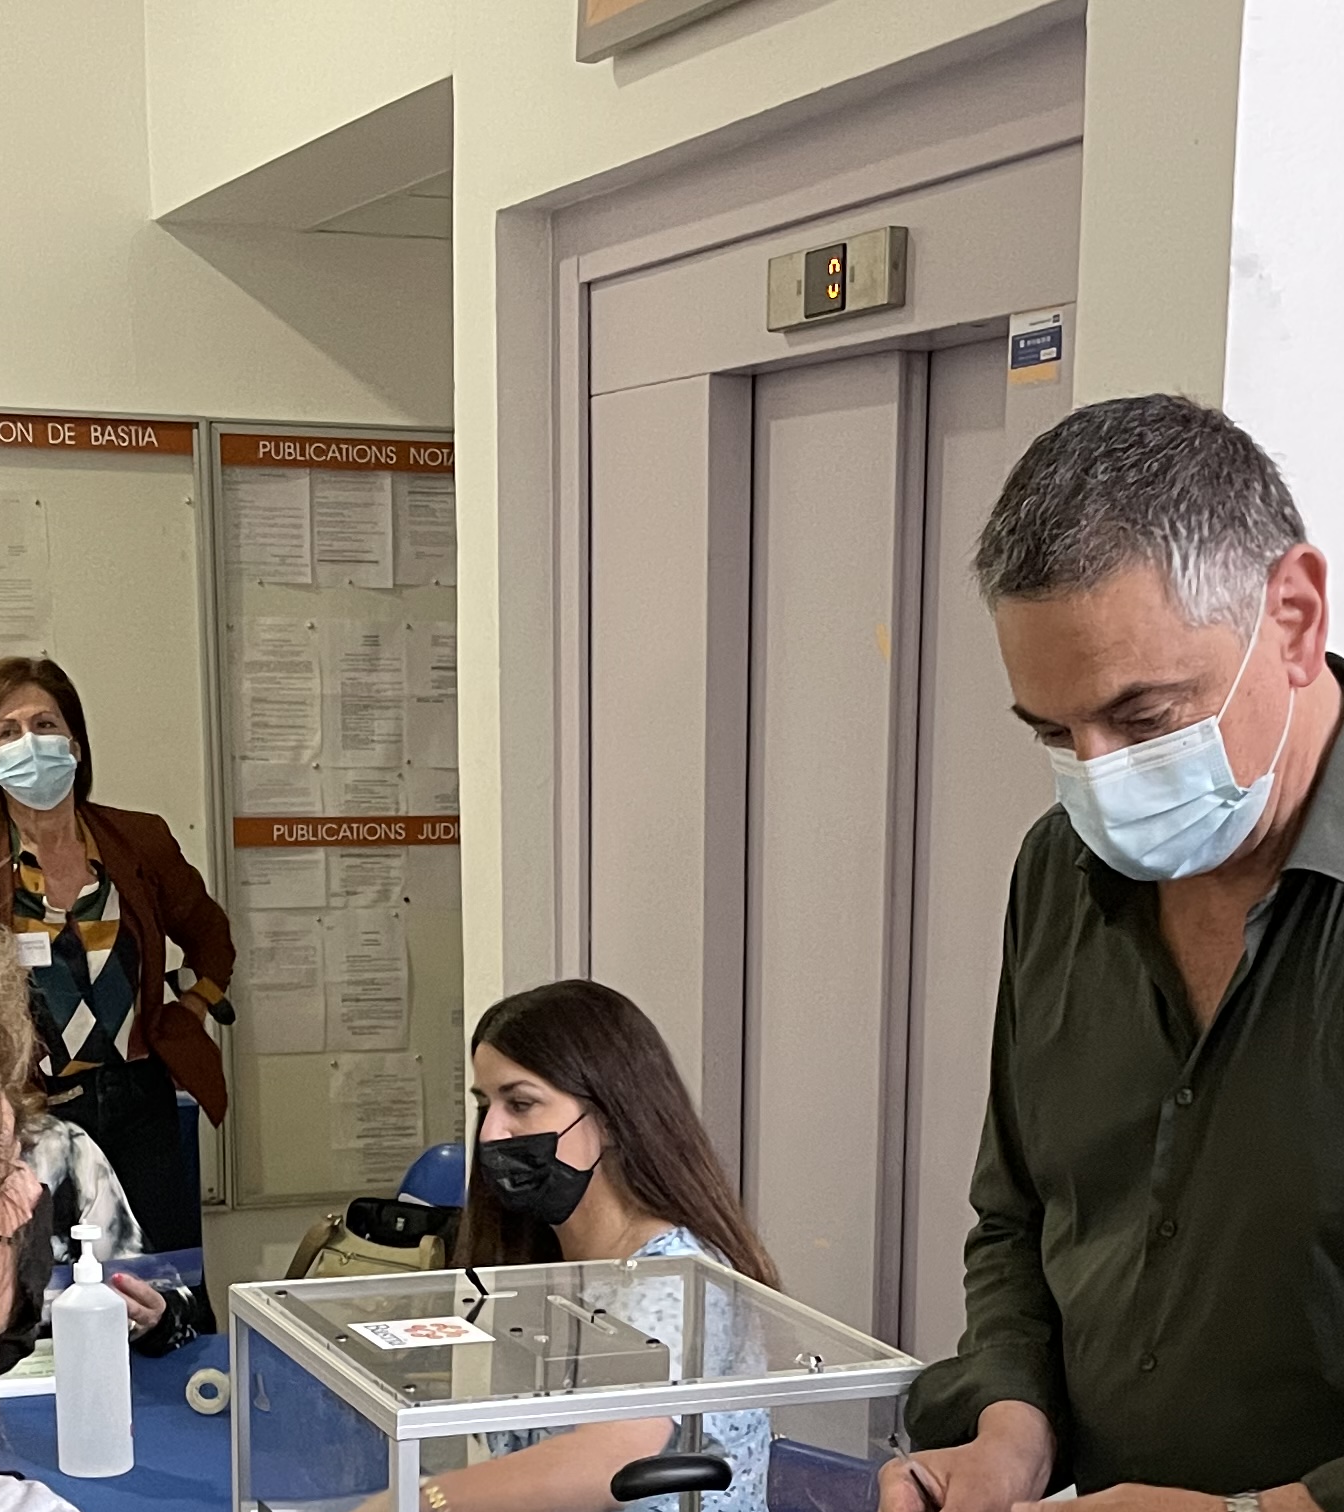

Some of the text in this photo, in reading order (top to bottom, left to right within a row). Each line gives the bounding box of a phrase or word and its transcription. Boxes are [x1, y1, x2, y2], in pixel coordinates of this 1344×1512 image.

[47, 422, 76, 445] DE
[90, 424, 159, 447] BASTIA
[258, 440, 397, 464] PUBLICATIONS
[272, 822, 407, 842] PUBLICATIONS
